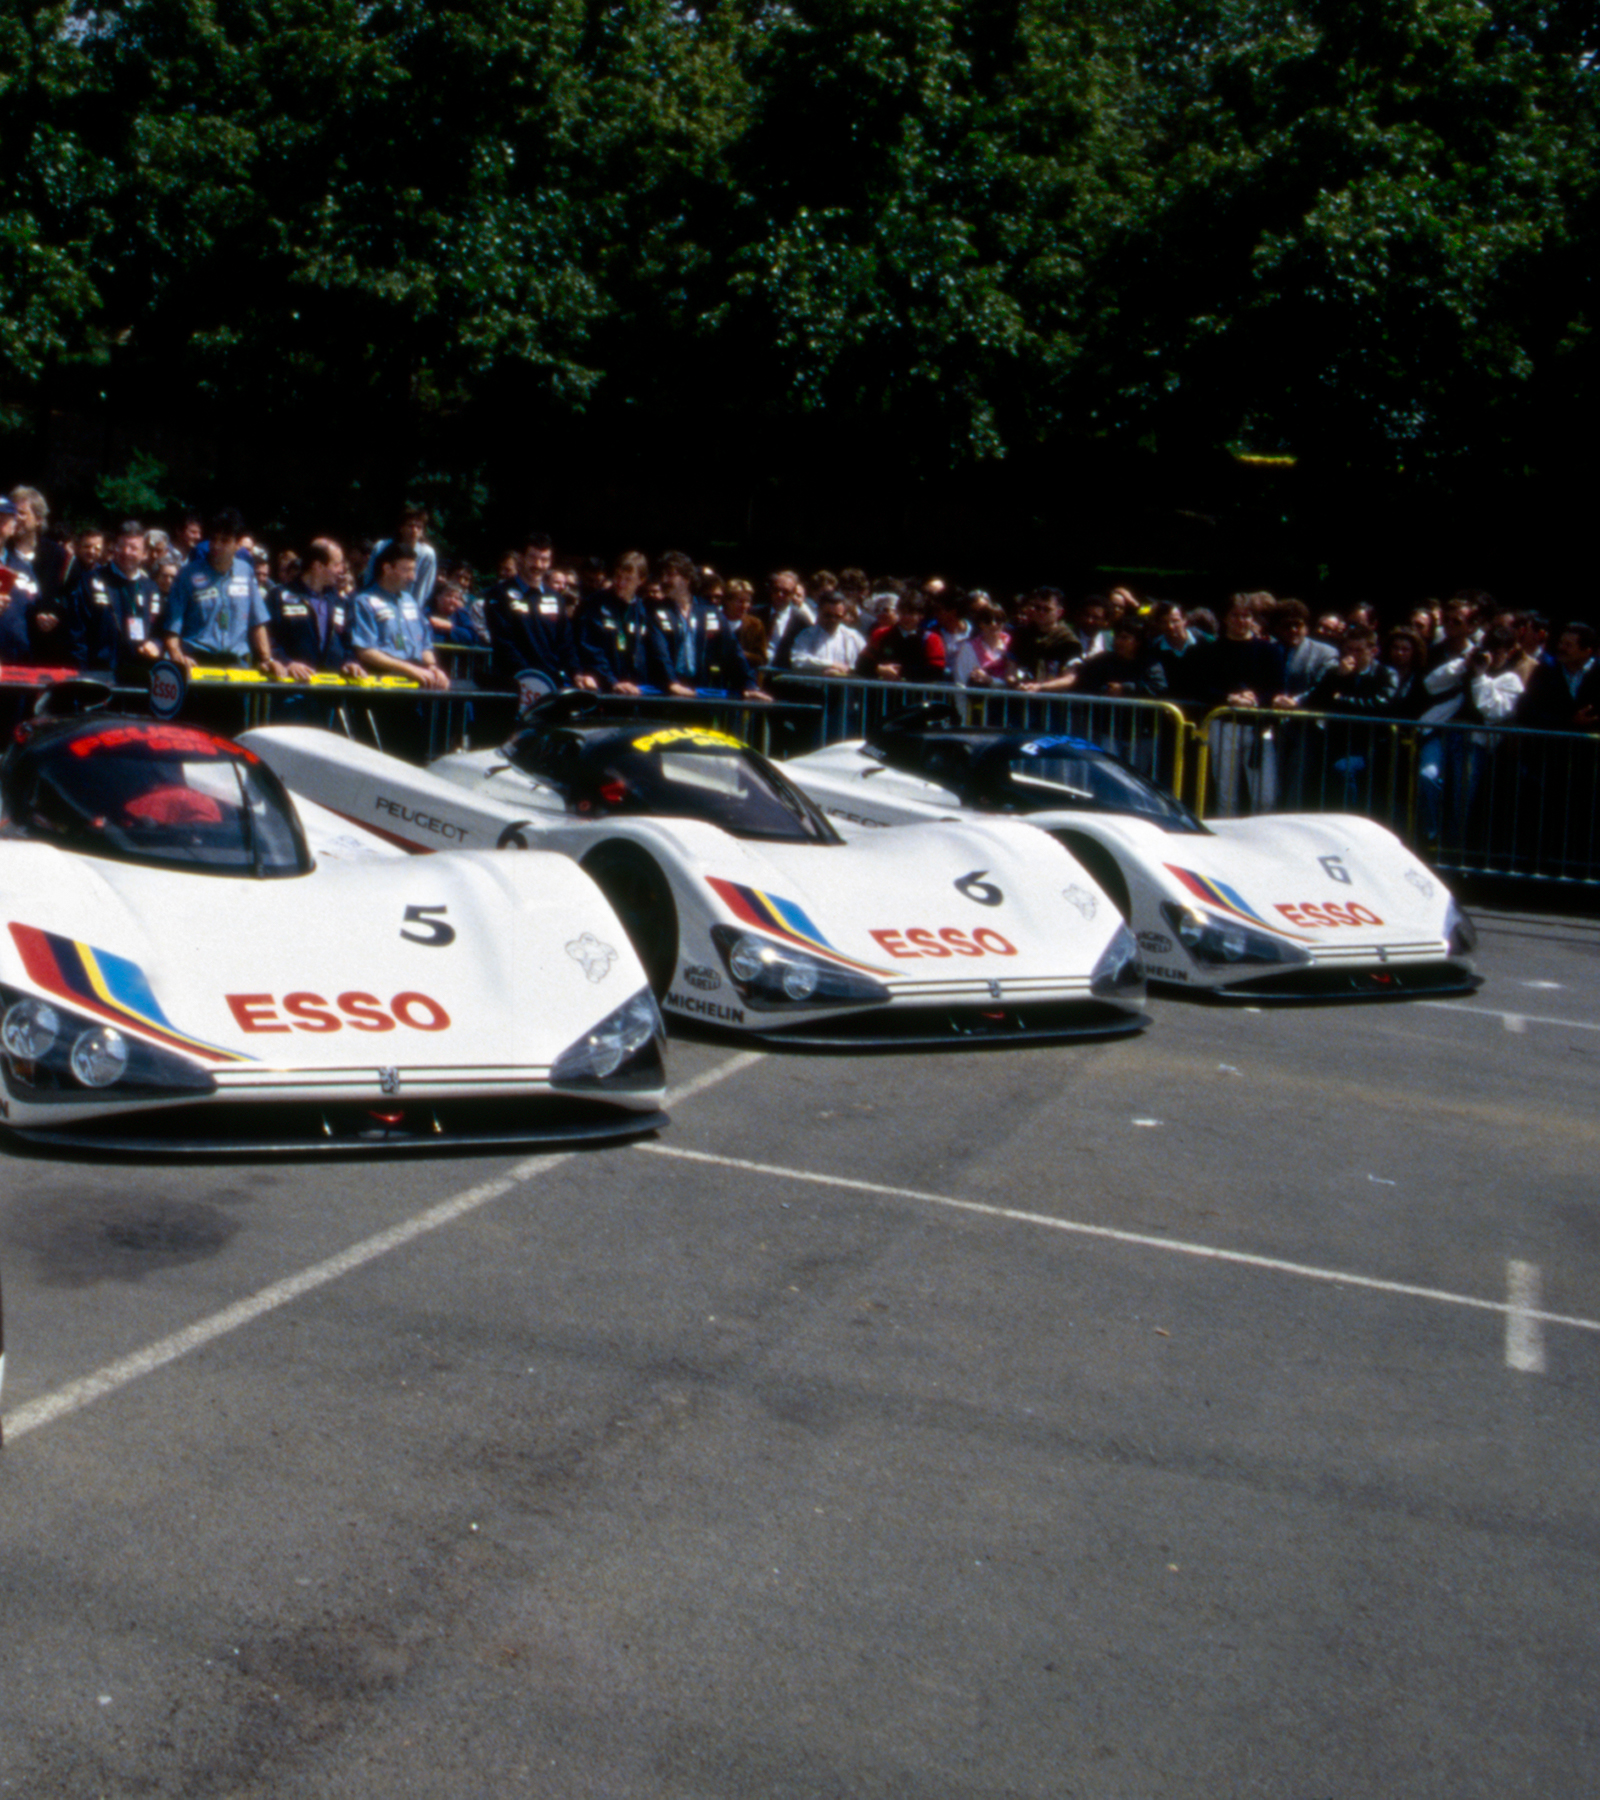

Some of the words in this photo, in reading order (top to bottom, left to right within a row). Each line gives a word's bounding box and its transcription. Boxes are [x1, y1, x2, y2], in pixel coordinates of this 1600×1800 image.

[375, 796, 469, 843] PEUGEOT
[1316, 855, 1352, 885] 6
[953, 870, 1004, 907] 6
[400, 904, 456, 947] 5
[1272, 901, 1385, 928] ESSO
[868, 927, 1018, 959] ESSO
[1145, 964, 1188, 982] HELIN
[224, 990, 452, 1034] ESSO
[667, 991, 745, 1024] MICHELIN
